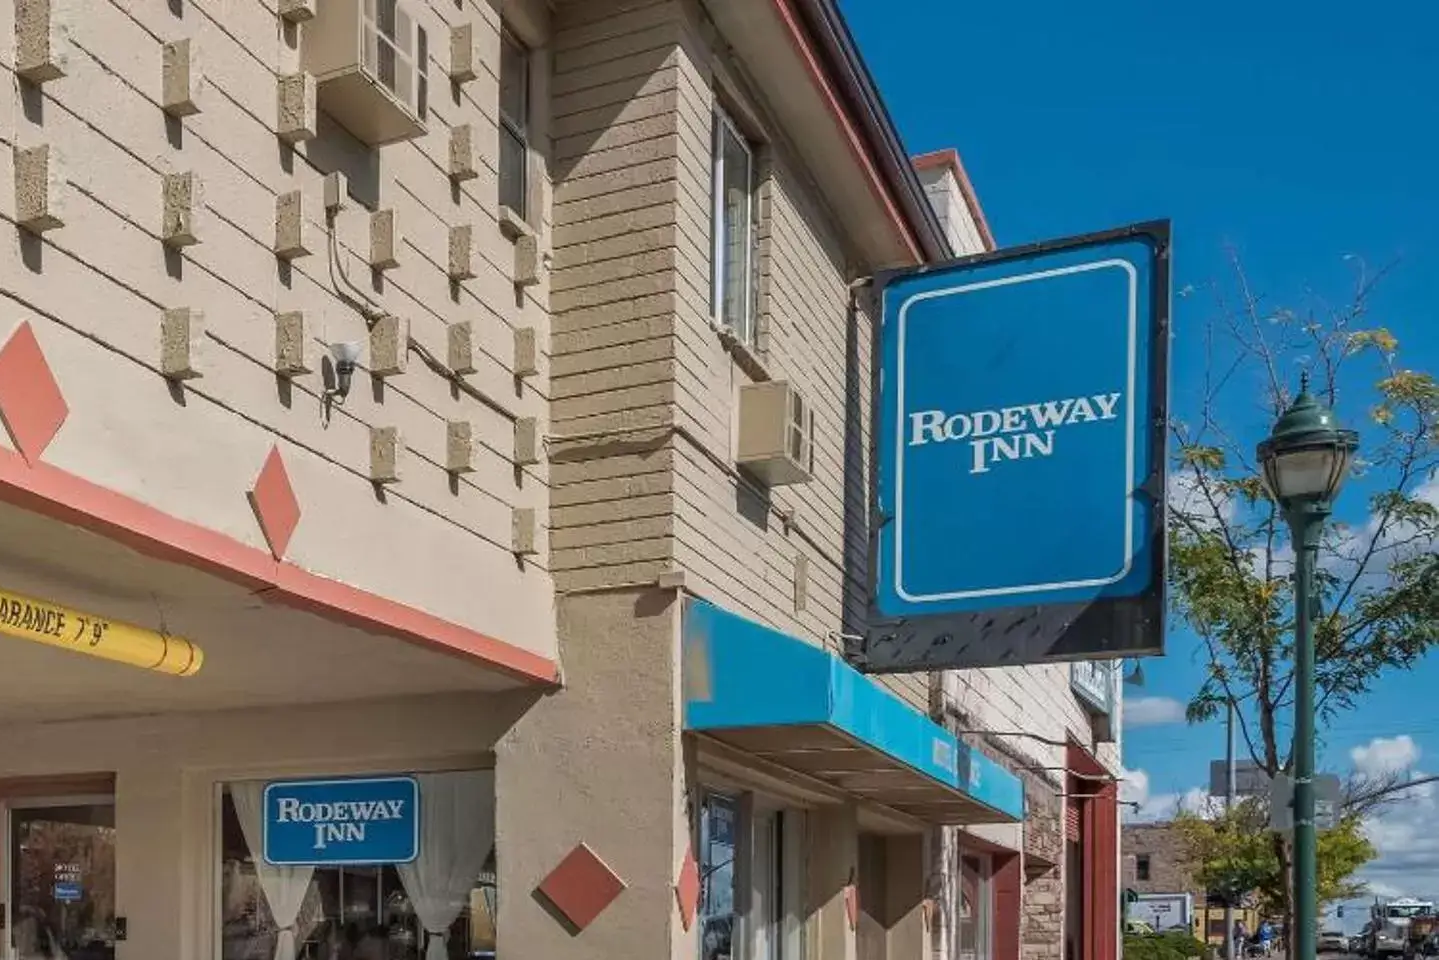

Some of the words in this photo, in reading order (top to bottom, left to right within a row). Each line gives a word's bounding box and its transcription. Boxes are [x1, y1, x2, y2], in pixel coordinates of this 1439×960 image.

[909, 392, 1121, 446] RODEWAY
[969, 430, 1056, 474] INN
[276, 797, 404, 823] RODEWAY
[313, 822, 366, 849] INN
